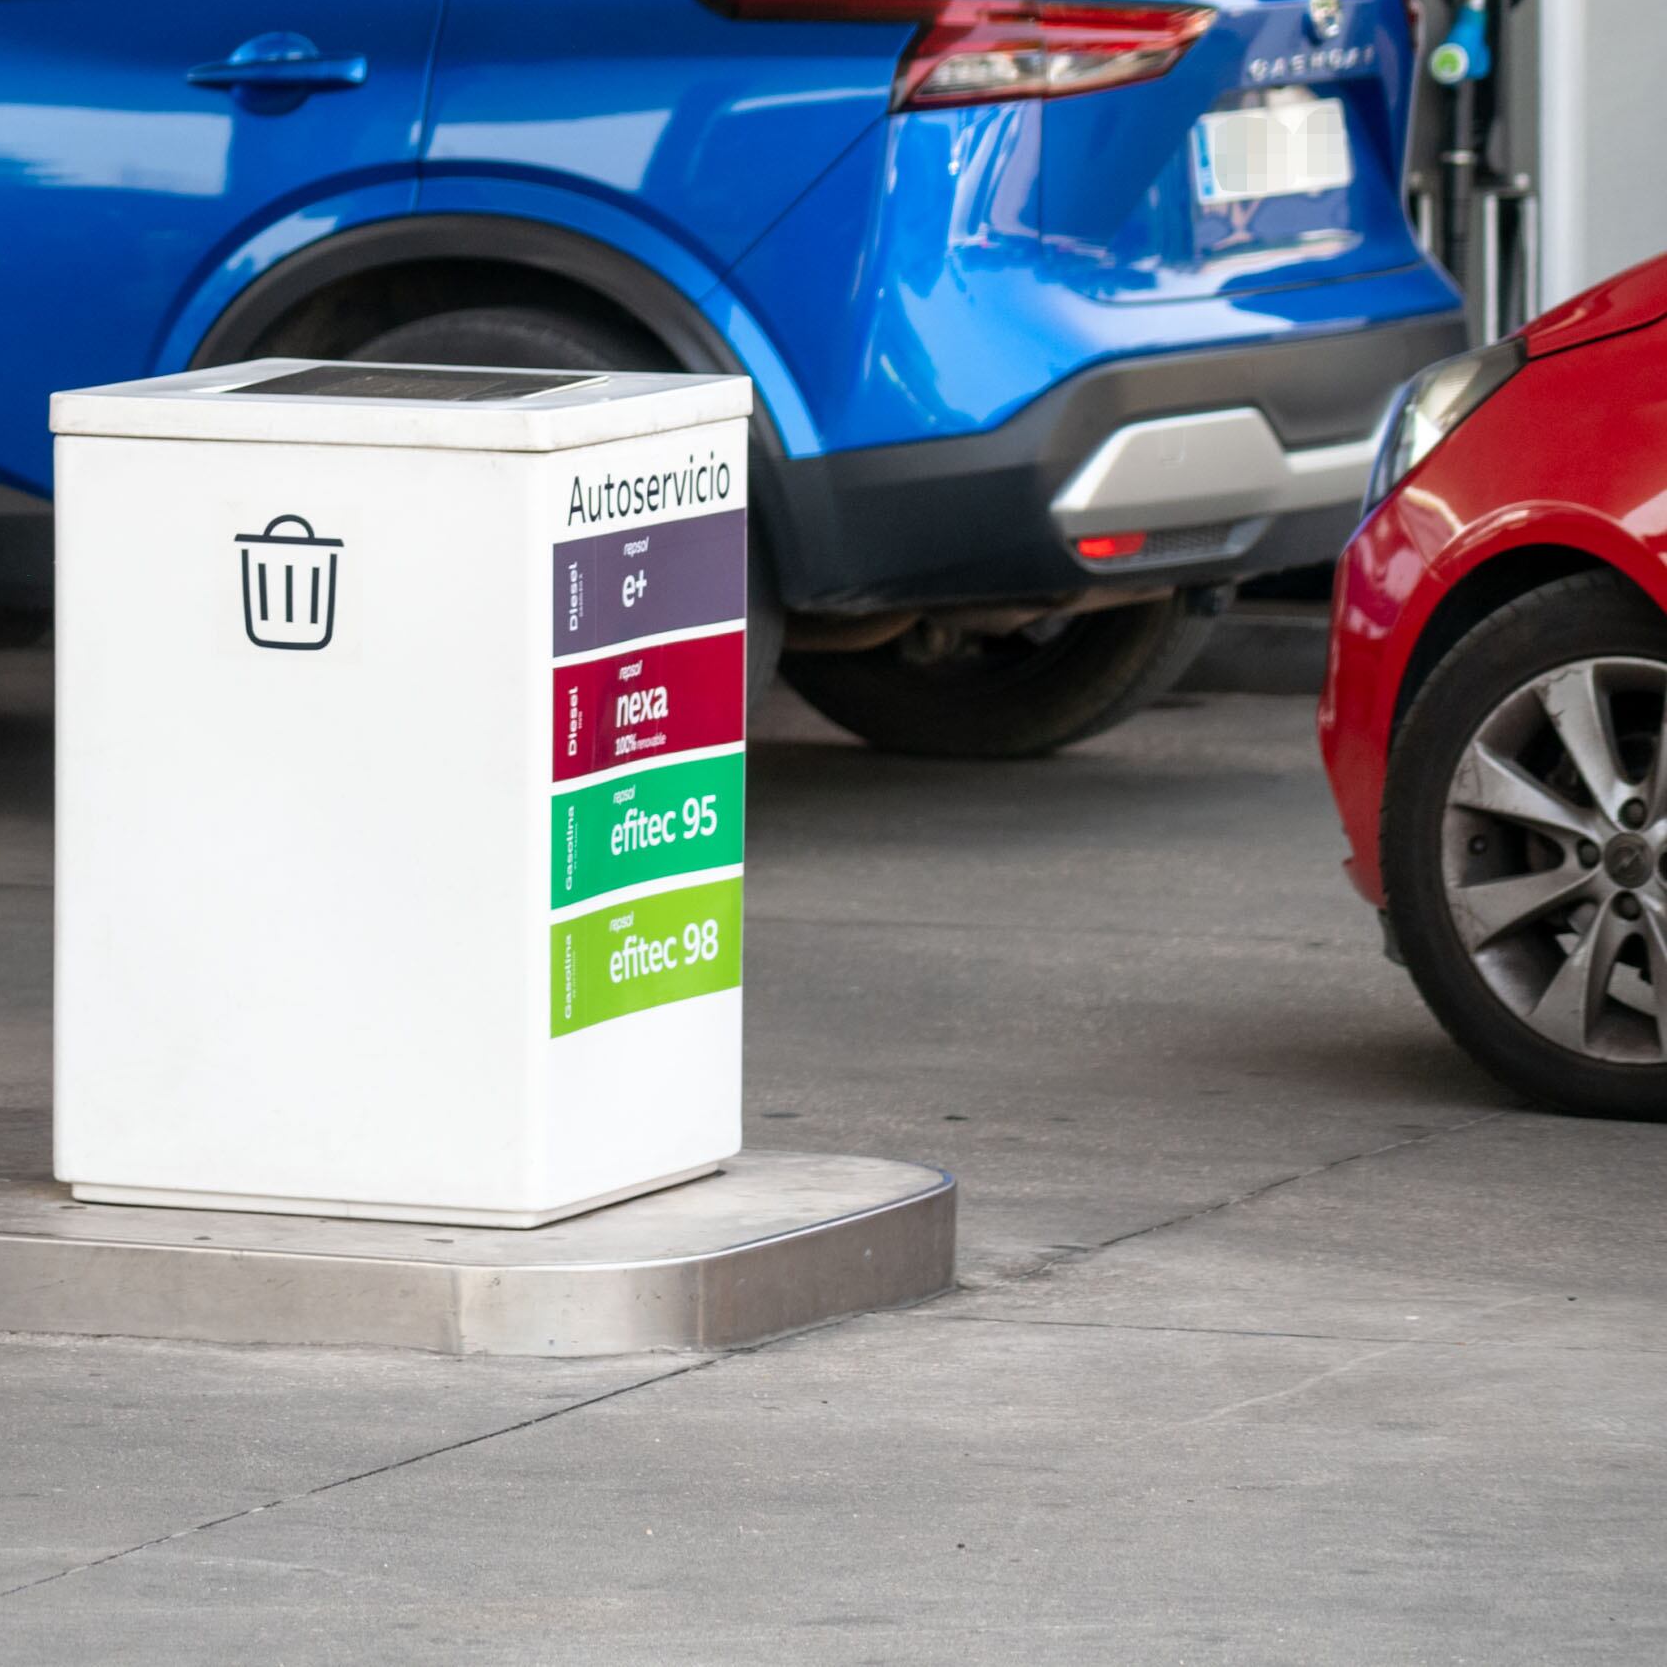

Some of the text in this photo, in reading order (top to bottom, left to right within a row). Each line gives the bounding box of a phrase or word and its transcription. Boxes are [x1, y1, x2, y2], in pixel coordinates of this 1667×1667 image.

[567, 450, 730, 527] Autoservicio
[623, 536, 650, 558] repsol
[568, 561, 578, 632] Diesel
[622, 569, 647, 608] e+
[619, 659, 643, 681] repsol
[568, 686, 578, 757] Diesel
[615, 685, 669, 728] nexa
[615, 733, 637, 756] 100%
[613, 784, 636, 805] repsol
[565, 805, 575, 891] Gasolina
[610, 807, 677, 856] efitec
[682, 794, 717, 840] 95
[609, 911, 634, 934] repsol
[564, 933, 572, 1020] Gasolina
[609, 934, 678, 984] efitec
[683, 918, 719, 965] 98
